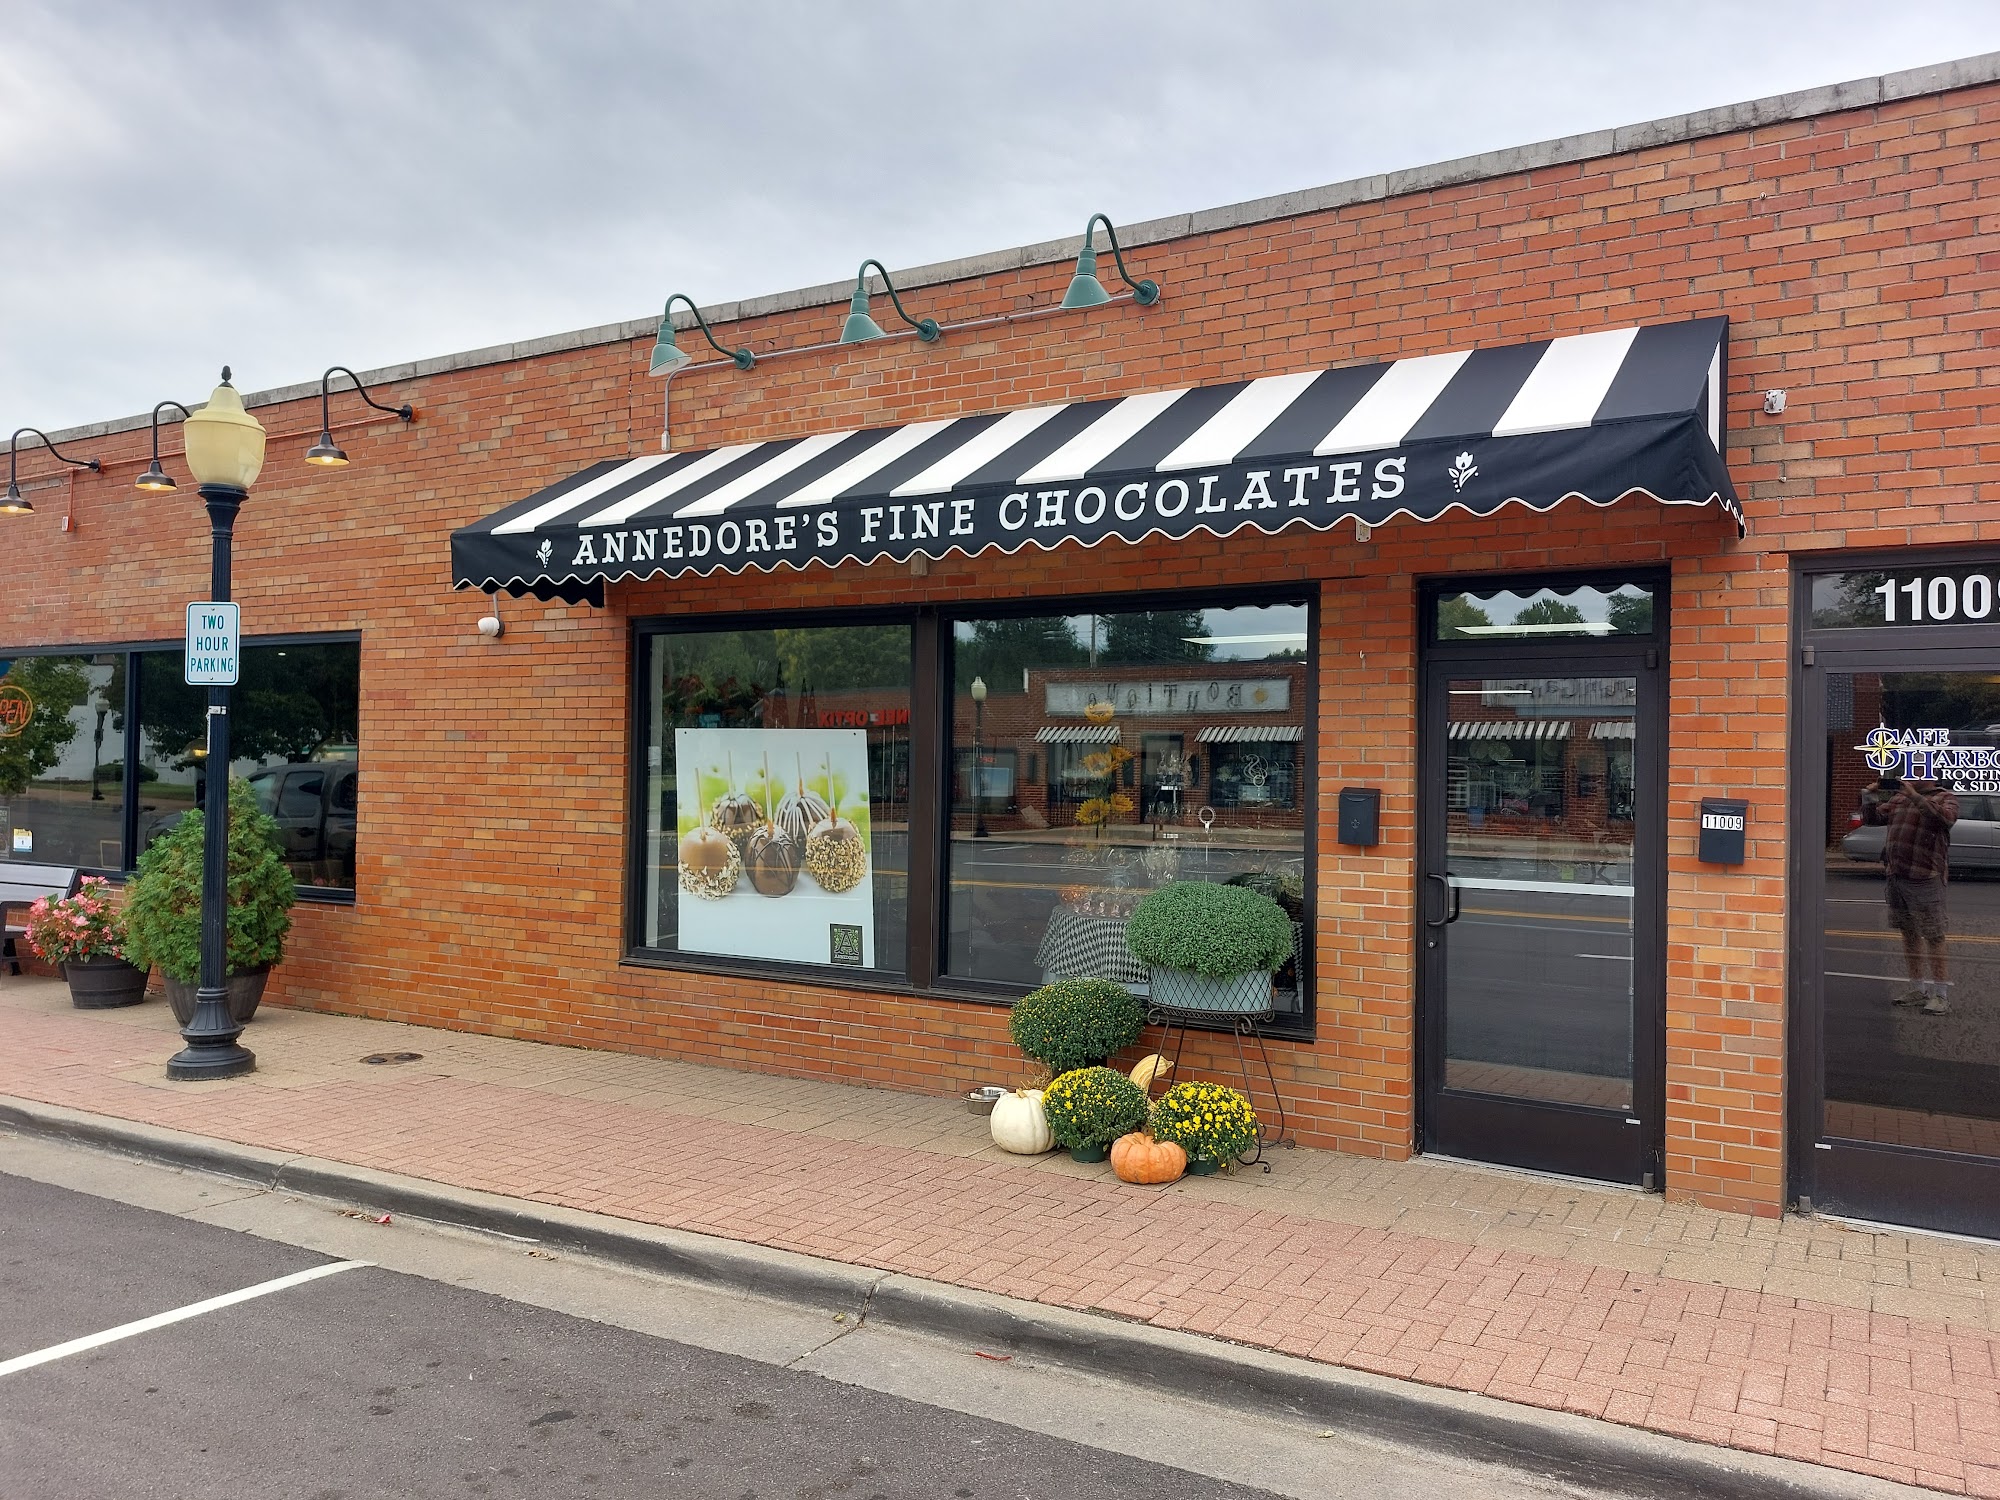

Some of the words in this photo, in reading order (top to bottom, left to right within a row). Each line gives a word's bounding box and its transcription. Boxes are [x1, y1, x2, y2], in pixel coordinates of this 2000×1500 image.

[571, 510, 839, 566] ANNEDORE'S
[860, 498, 975, 543] FINE
[998, 456, 1407, 531] CHOCOLATES
[1875, 574, 2000, 622] 1100
[202, 615, 224, 630] TWO
[196, 636, 229, 651] HOUR
[190, 657, 234, 673] PARKING
[1952, 781, 1967, 792] &
[1704, 815, 1742, 829] 11009
